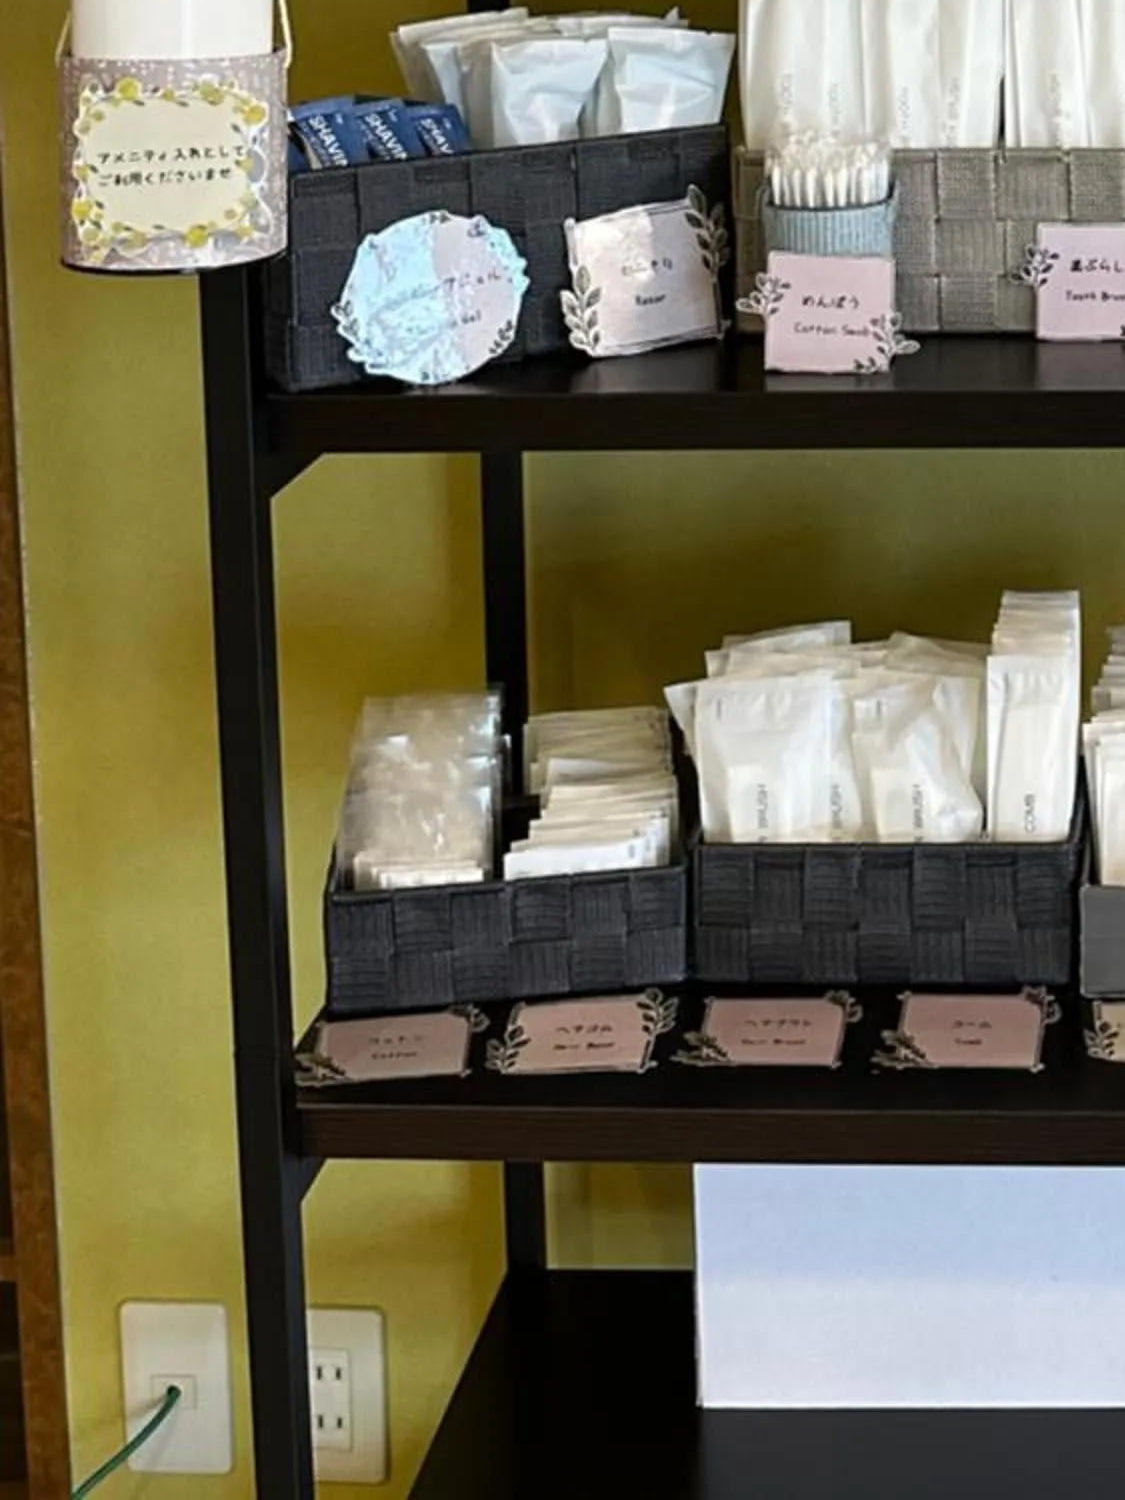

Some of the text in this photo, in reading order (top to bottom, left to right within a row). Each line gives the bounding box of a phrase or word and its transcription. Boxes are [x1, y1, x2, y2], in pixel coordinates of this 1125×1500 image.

[97, 167, 233, 187] ご利用くださいませ
[1025, 792, 1036, 832] COMB
